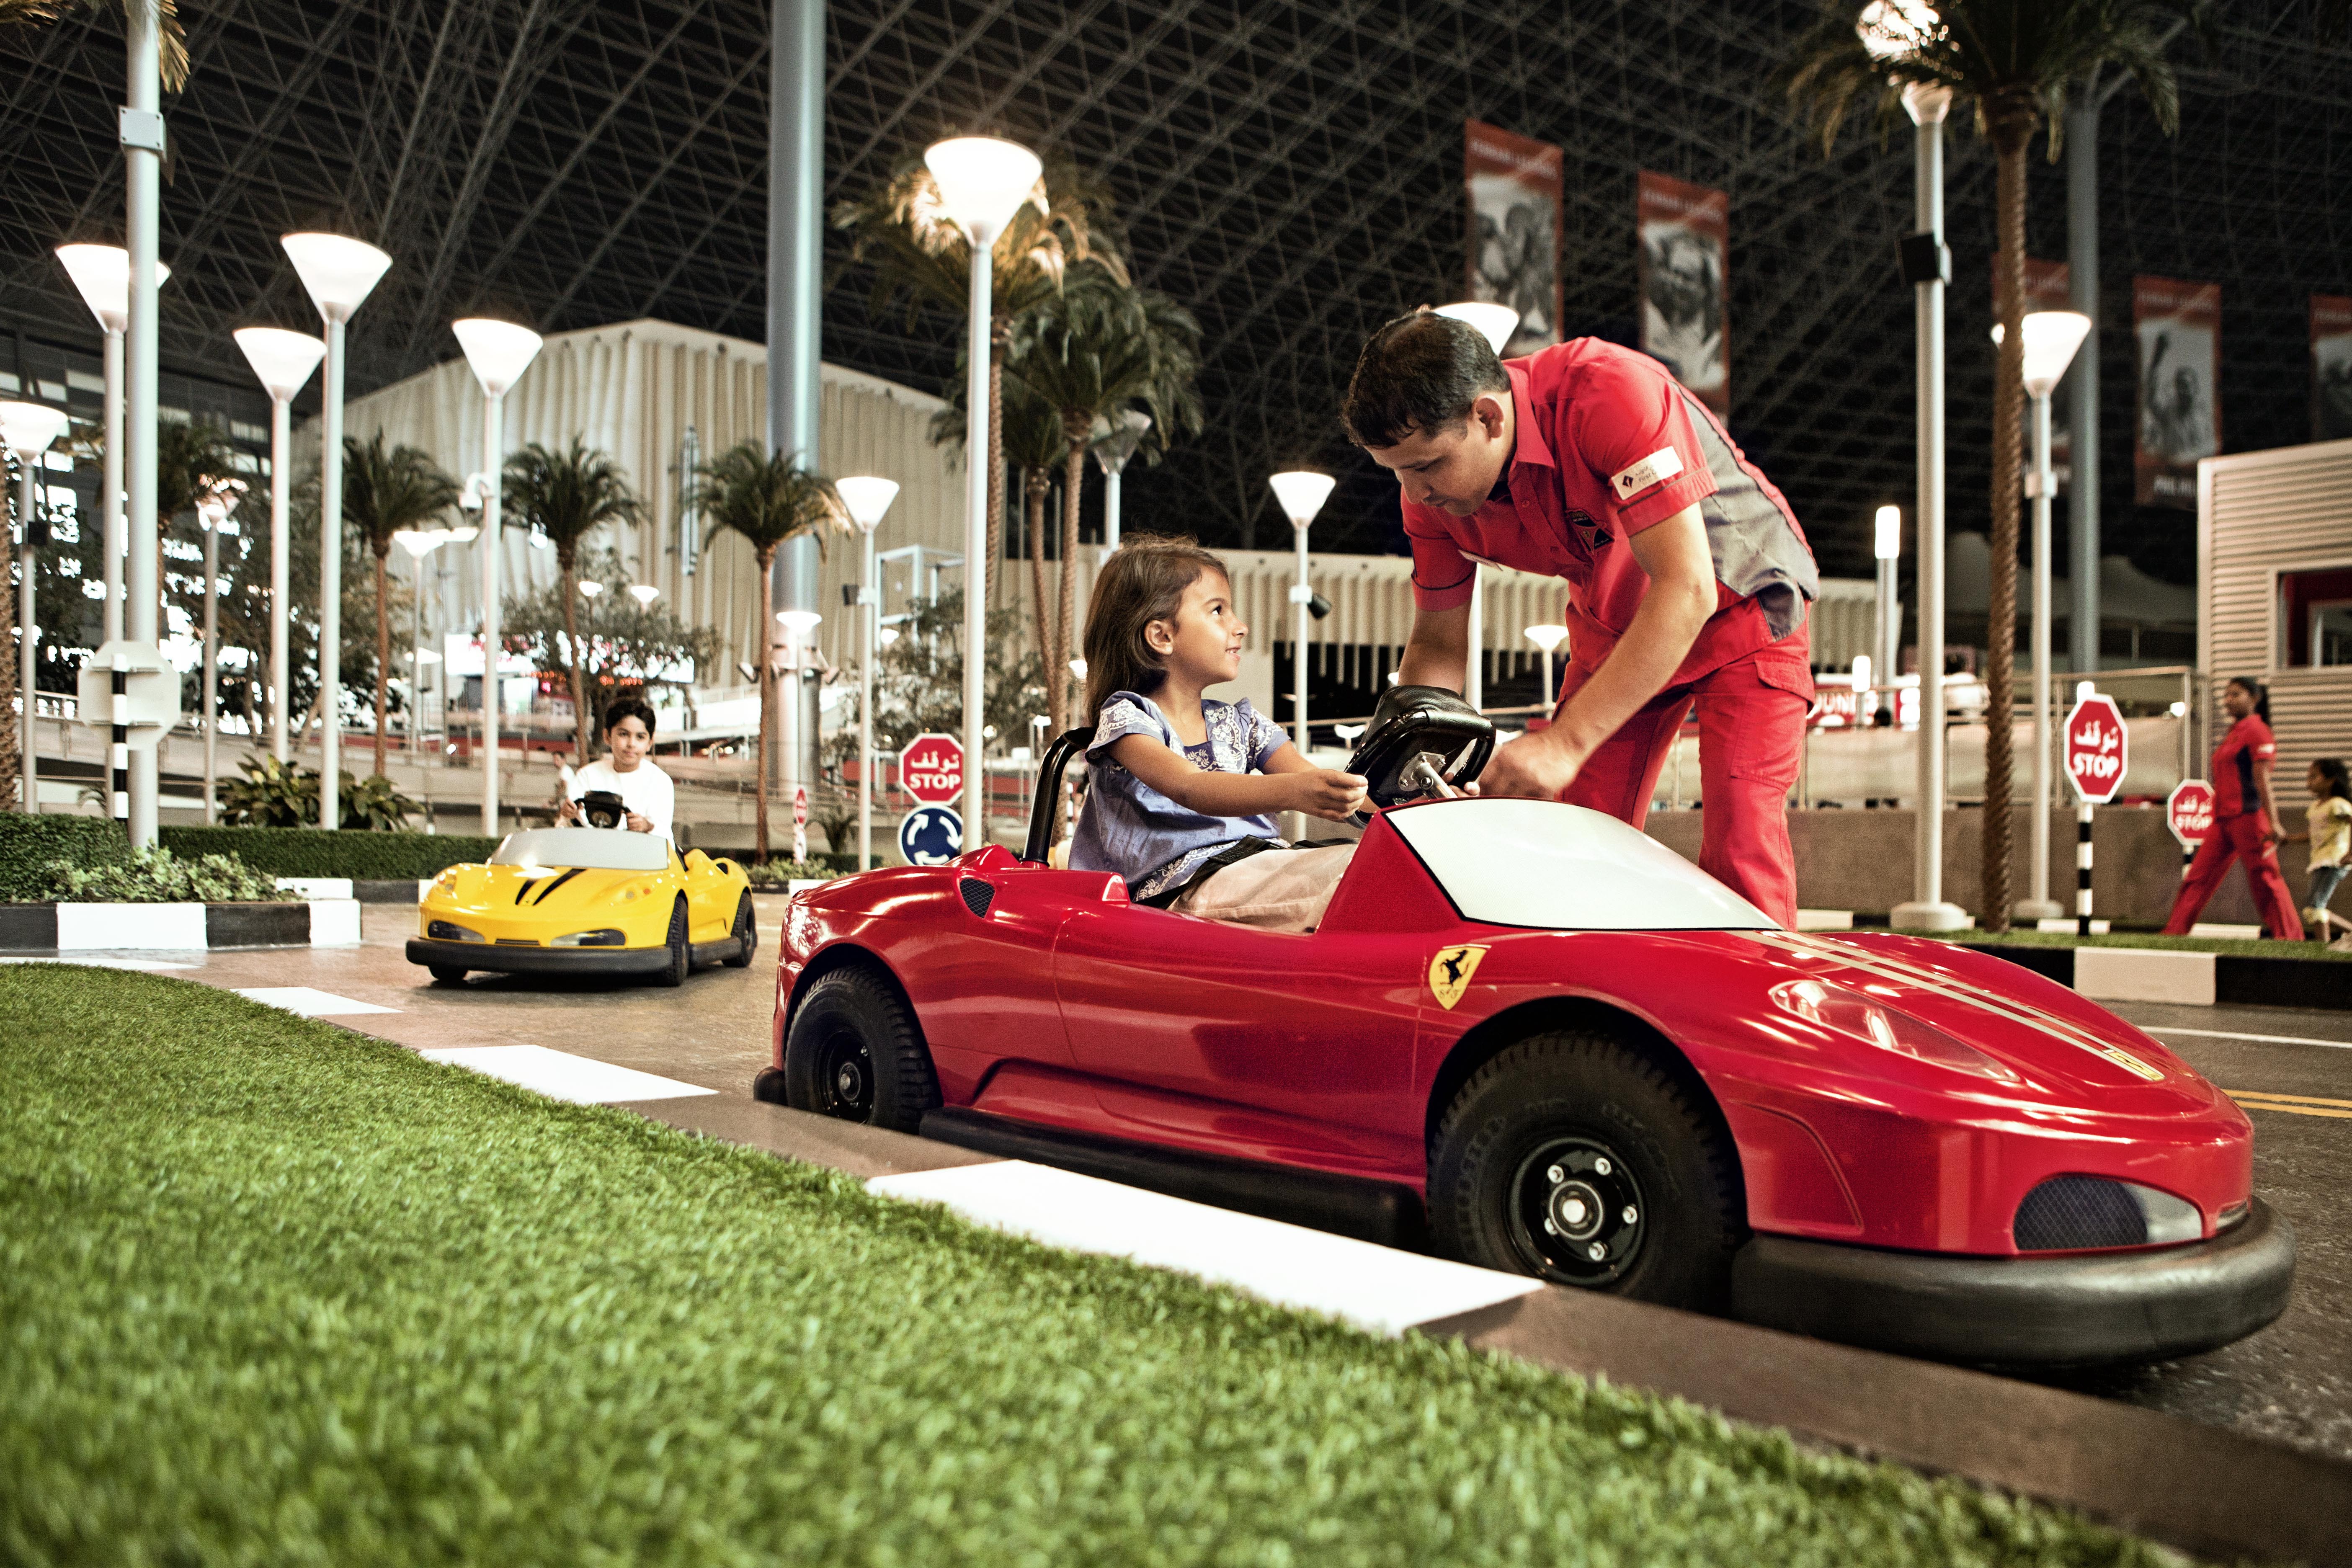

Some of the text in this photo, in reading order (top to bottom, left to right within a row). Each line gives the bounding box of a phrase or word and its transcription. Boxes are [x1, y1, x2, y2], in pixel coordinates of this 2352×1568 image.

[2074, 720, 2118, 754] توقف
[910, 750, 959, 773] توقف
[2073, 752, 2120, 779] STOP
[909, 773, 961, 790] STOP
